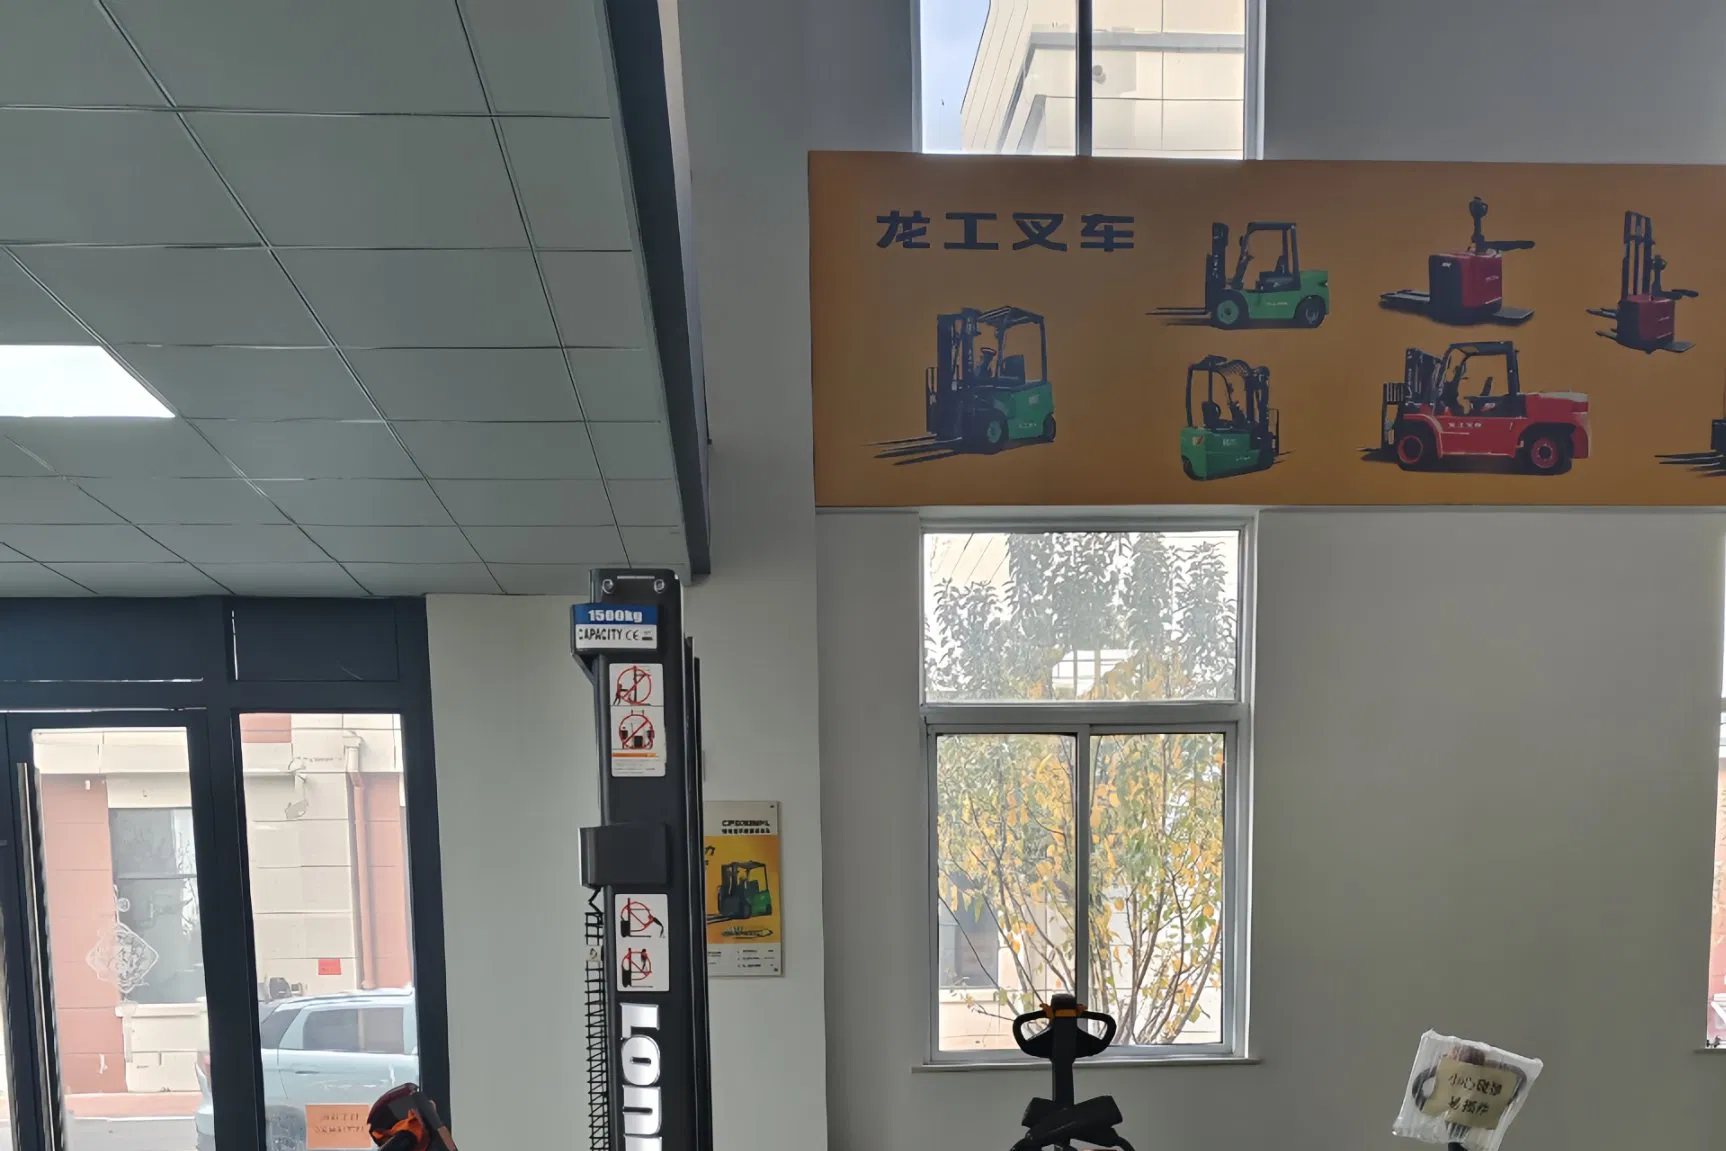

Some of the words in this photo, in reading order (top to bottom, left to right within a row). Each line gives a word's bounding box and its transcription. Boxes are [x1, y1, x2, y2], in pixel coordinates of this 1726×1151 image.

[876, 210, 1134, 252] 龙工叉车
[588, 609, 643, 623] 1500kg
[578, 628, 623, 641] CAPACITY
